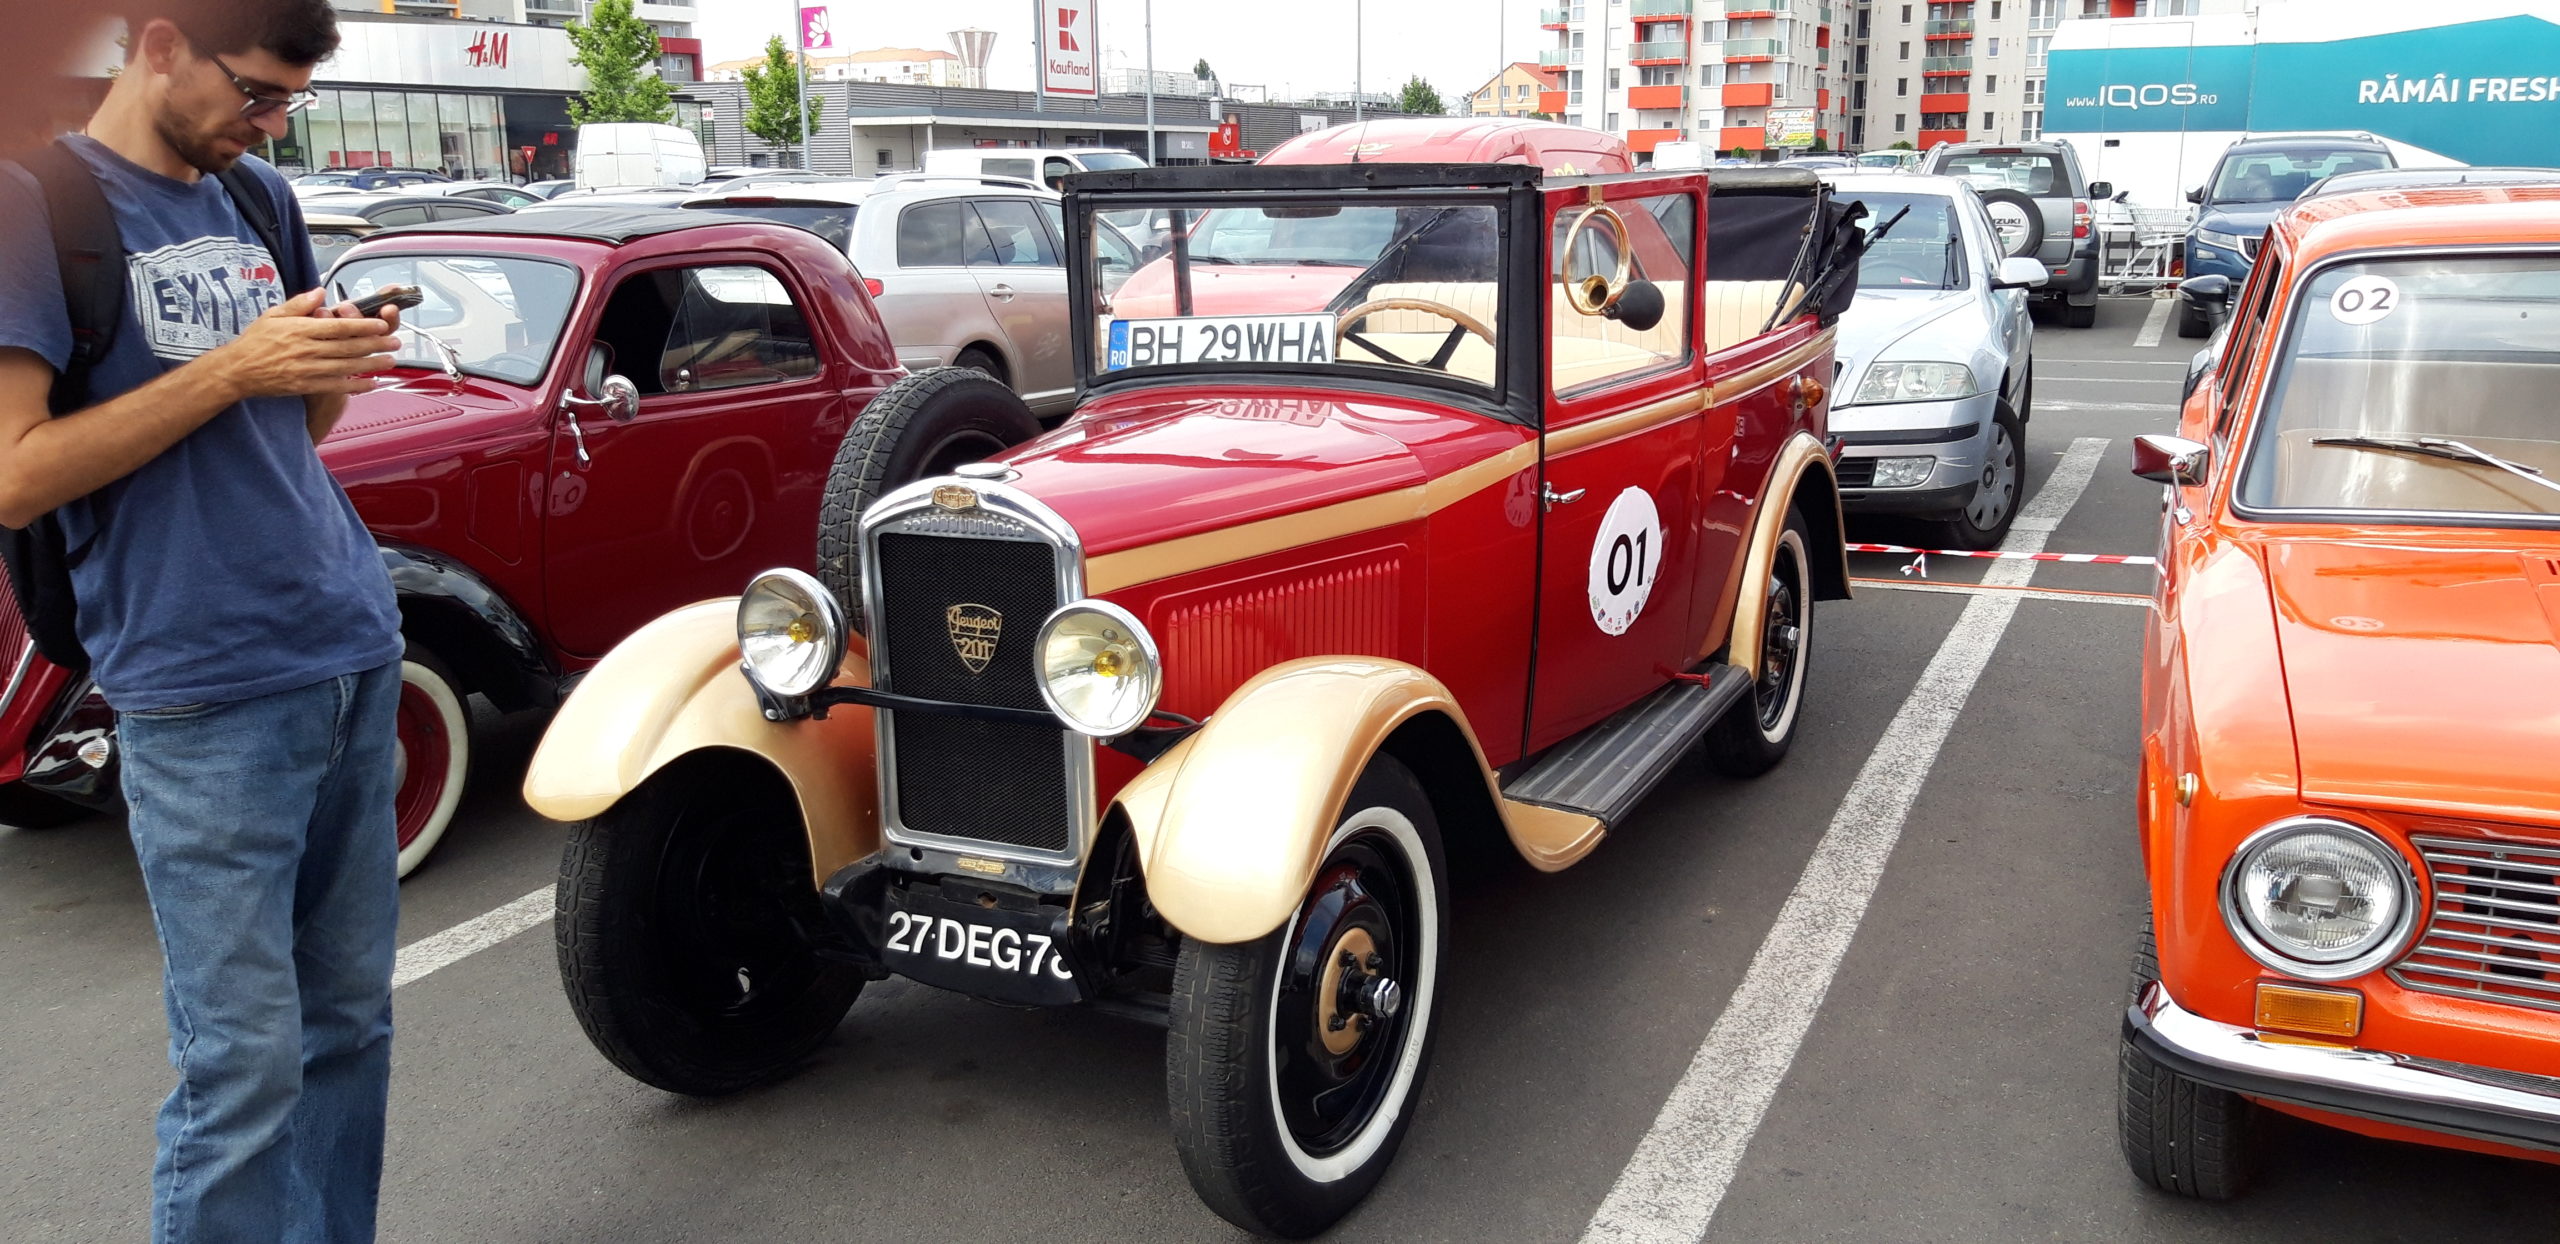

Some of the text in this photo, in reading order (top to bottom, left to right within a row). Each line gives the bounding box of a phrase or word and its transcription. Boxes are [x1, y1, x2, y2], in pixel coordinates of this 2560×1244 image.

[468, 30, 508, 68] H&M
[1050, 59, 1090, 76] Kaufland
[2358, 73, 2459, 103] RĂMÂI
[153, 266, 240, 335] EXIT
[2339, 288, 2391, 312] 02
[1111, 350, 1126, 366] RO
[1131, 326, 1183, 366] BH
[1607, 527, 1647, 596] 01
[950, 606, 1000, 636] Peugeot
[961, 637, 989, 660] 201
